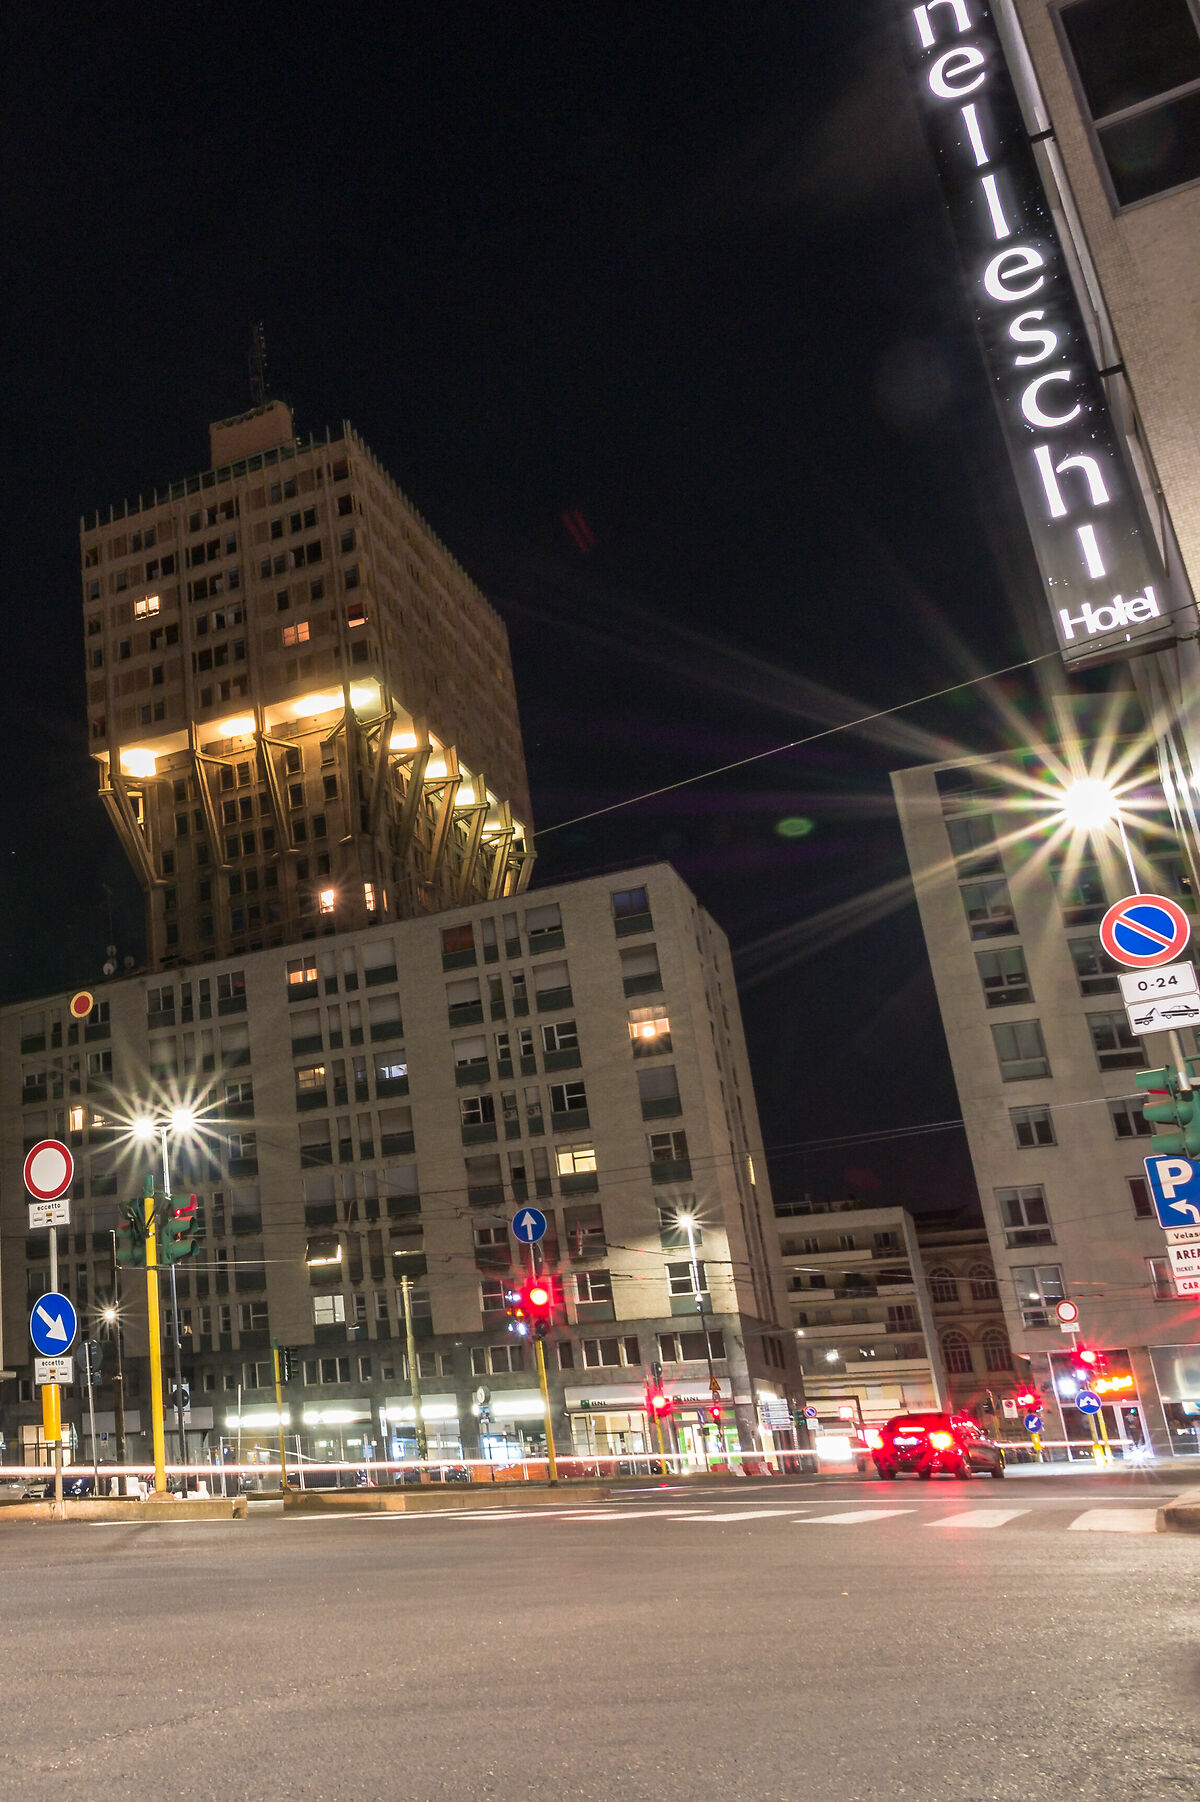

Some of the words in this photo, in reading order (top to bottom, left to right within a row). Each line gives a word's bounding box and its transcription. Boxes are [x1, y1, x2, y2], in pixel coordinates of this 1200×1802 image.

[1059, 586, 1160, 640] Hotel
[1155, 1158, 1193, 1199] P
[37, 1203, 61, 1211] eccetto
[1173, 1231, 1200, 1240] Velas
